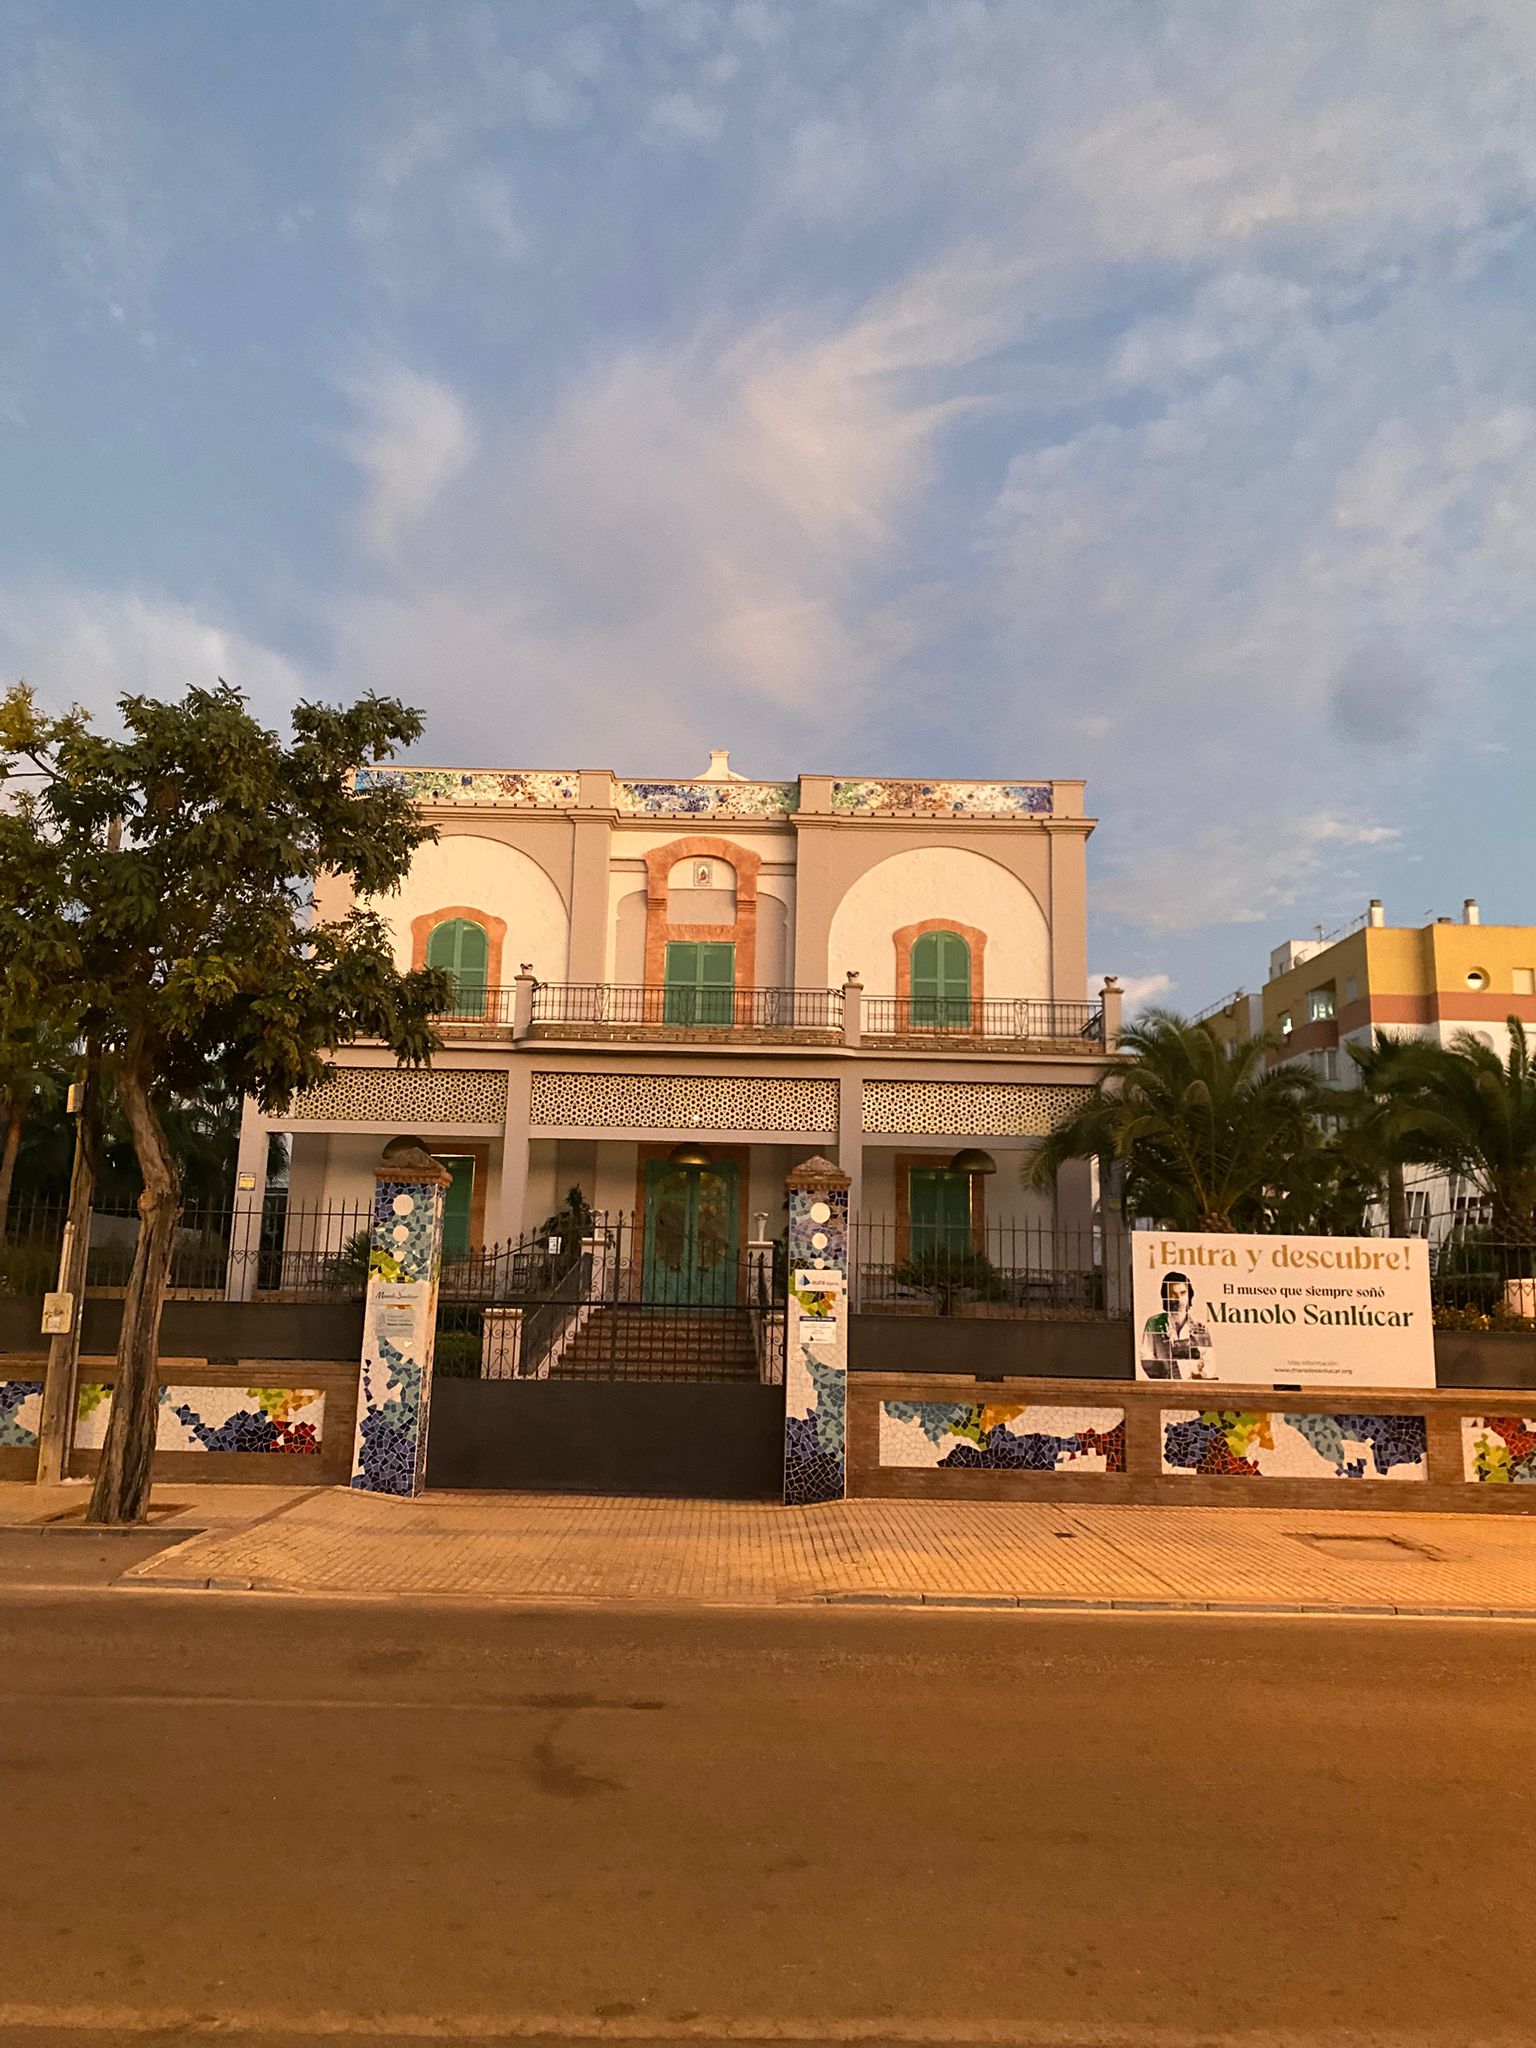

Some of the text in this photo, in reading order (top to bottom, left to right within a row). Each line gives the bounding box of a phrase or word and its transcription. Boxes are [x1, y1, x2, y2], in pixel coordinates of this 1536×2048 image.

[1148, 1241, 1411, 1273] ¡Entra y descubre!
[1223, 1284, 1385, 1299] El museo que siempre soñó
[1206, 1302, 1414, 1327] Manolo Sanlúcar
